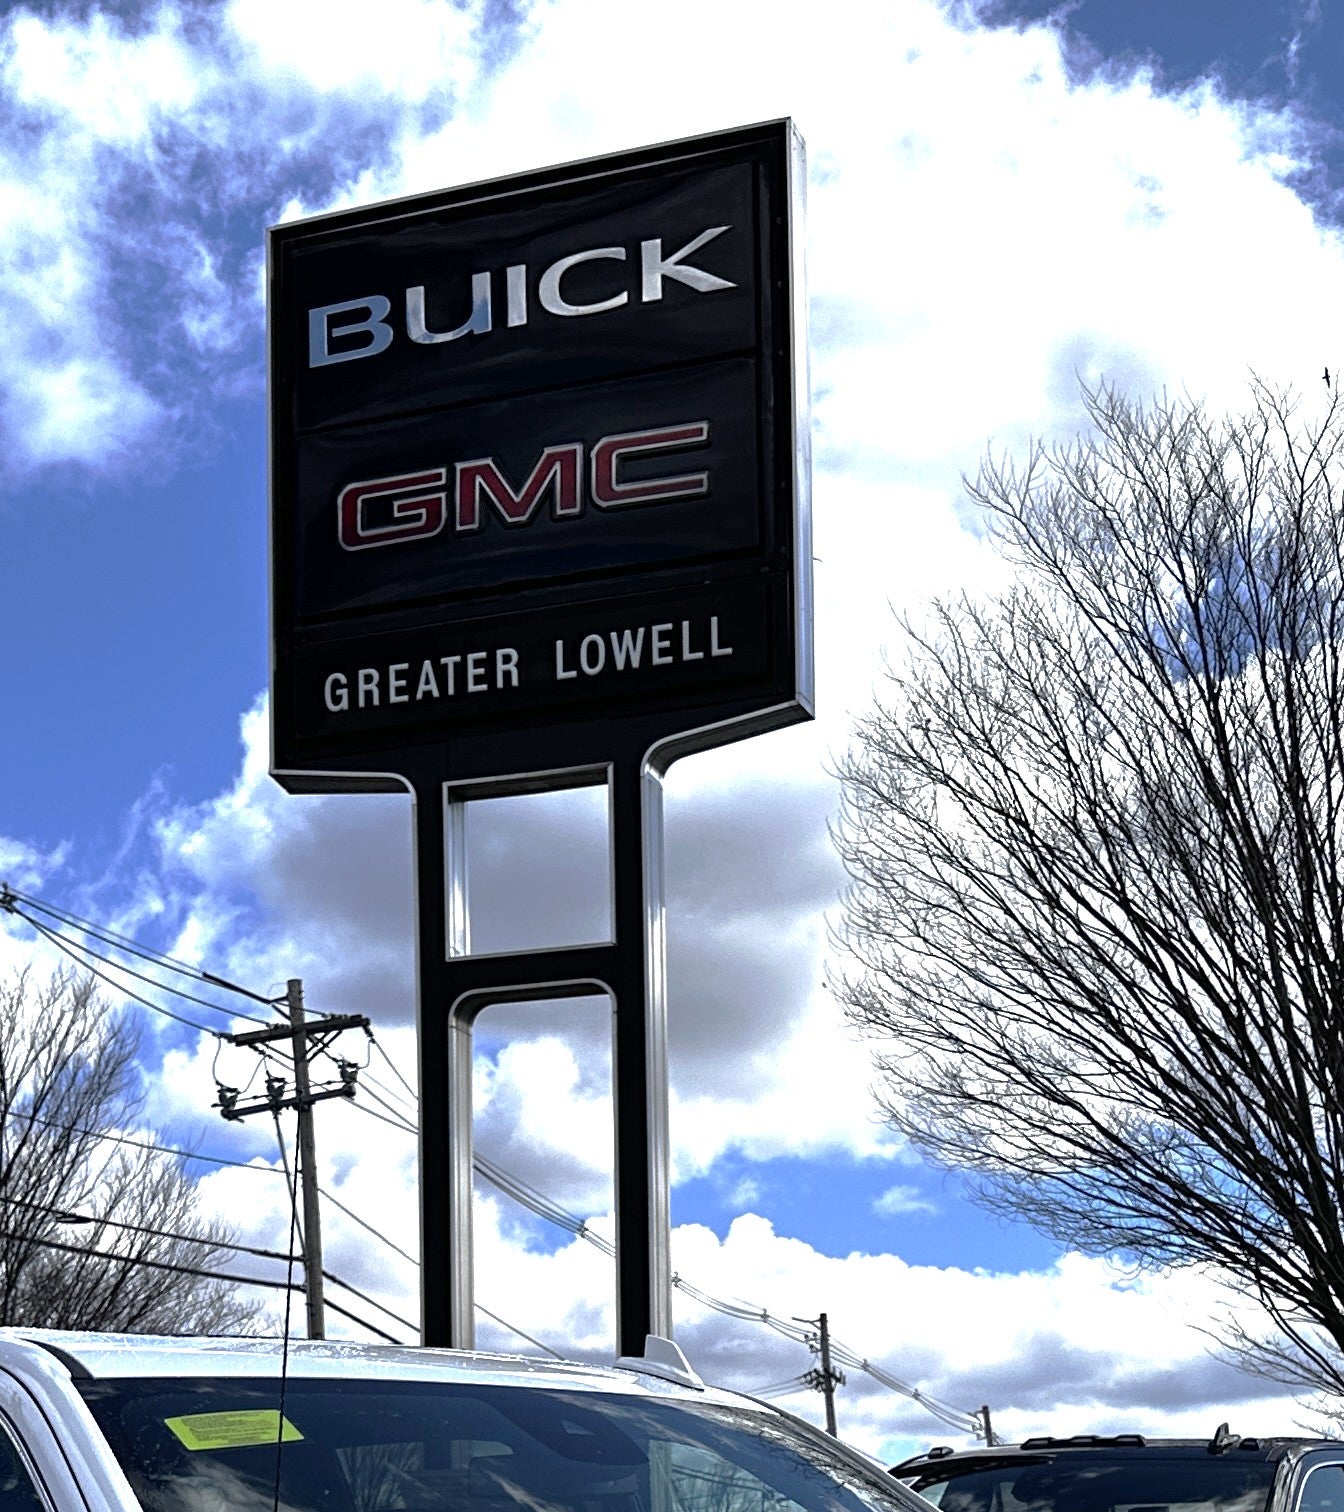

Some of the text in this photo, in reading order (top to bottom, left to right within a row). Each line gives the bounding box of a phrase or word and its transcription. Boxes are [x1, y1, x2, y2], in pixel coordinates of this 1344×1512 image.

[308, 224, 738, 369] BUICK
[337, 420, 710, 552] GMC
[324, 615, 733, 713] GREATER LOWELL
